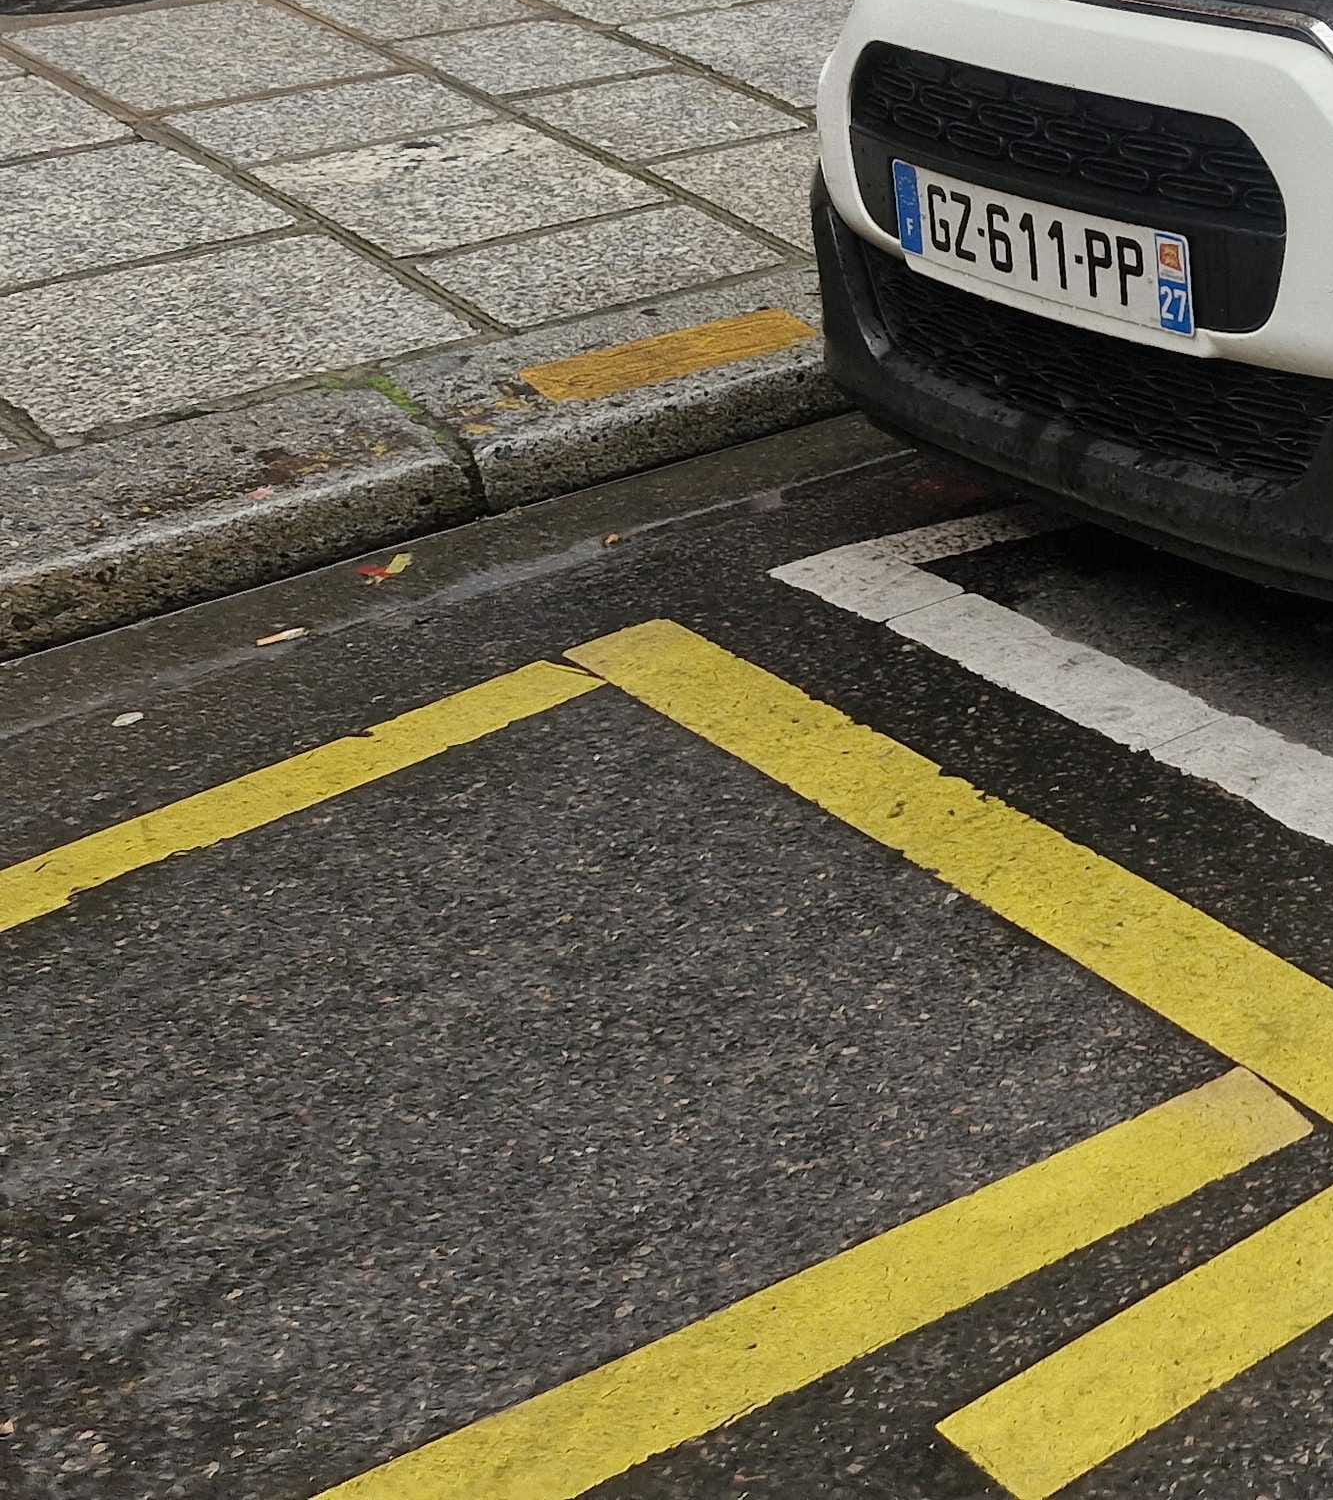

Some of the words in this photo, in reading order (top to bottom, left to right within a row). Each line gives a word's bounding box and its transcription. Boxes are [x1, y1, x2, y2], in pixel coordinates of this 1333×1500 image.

[906, 216, 915, 236] F
[927, 184, 1144, 306] GZ-611-PP
[1160, 285, 1188, 323] 27
